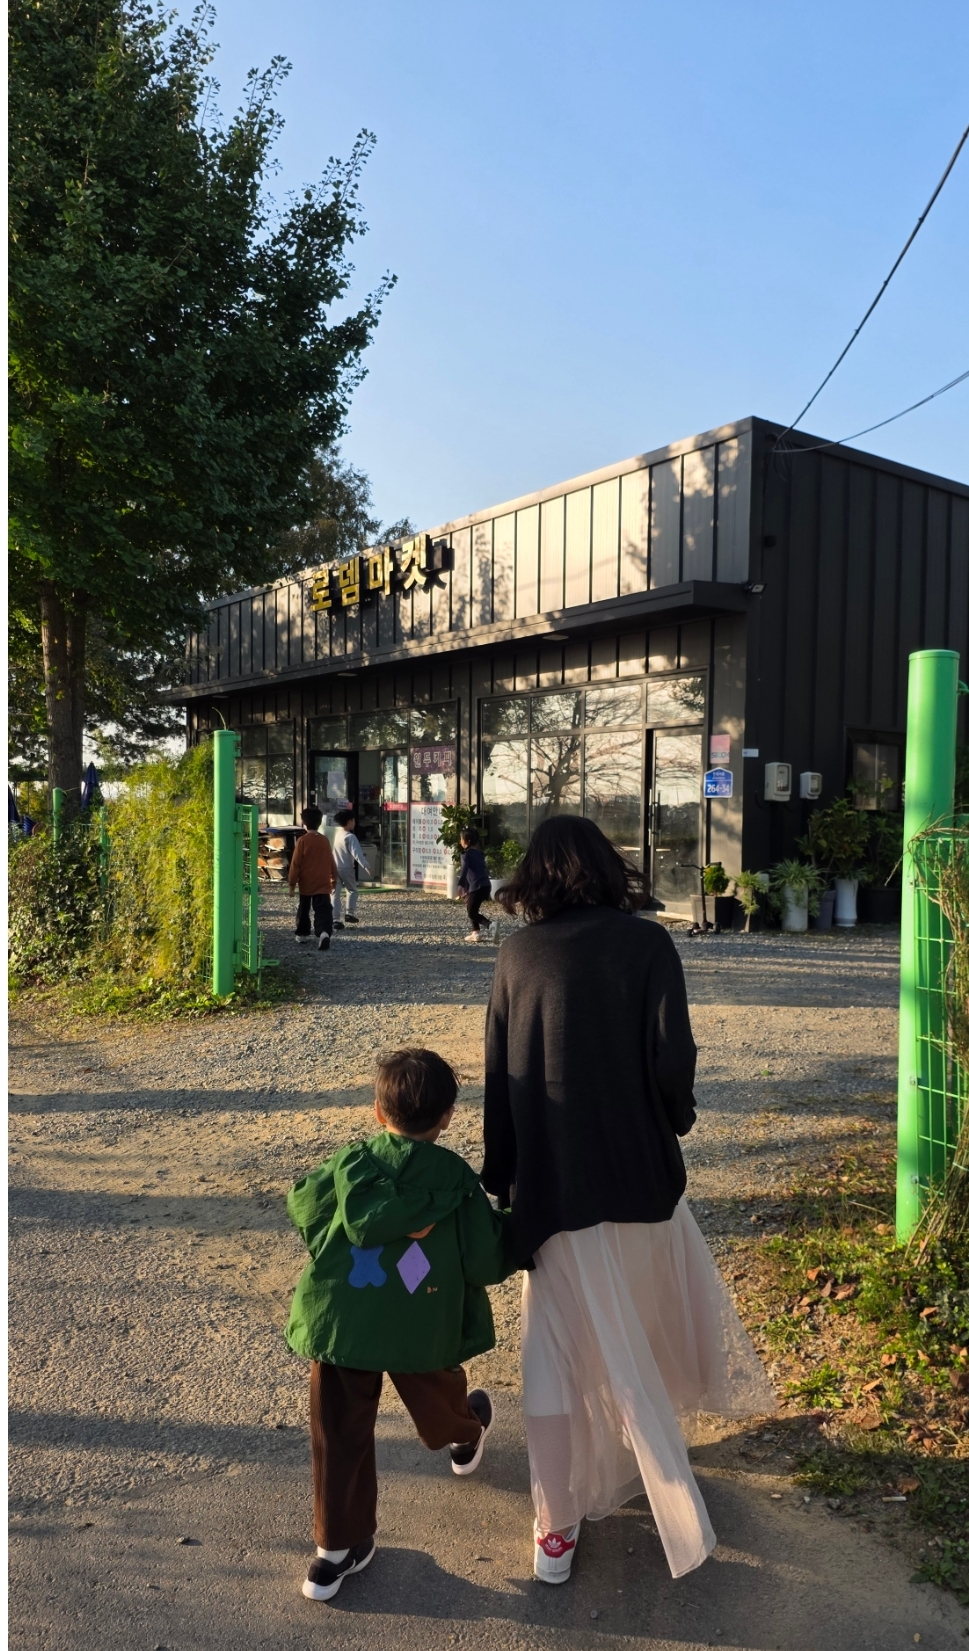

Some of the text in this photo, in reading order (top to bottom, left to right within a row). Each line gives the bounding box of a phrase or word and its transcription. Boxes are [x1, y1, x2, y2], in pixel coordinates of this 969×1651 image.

[310, 533, 427, 612] 로뎀마켓
[413, 750, 452, 769] 원두커피
[707, 784, 730, 793] 264-34
